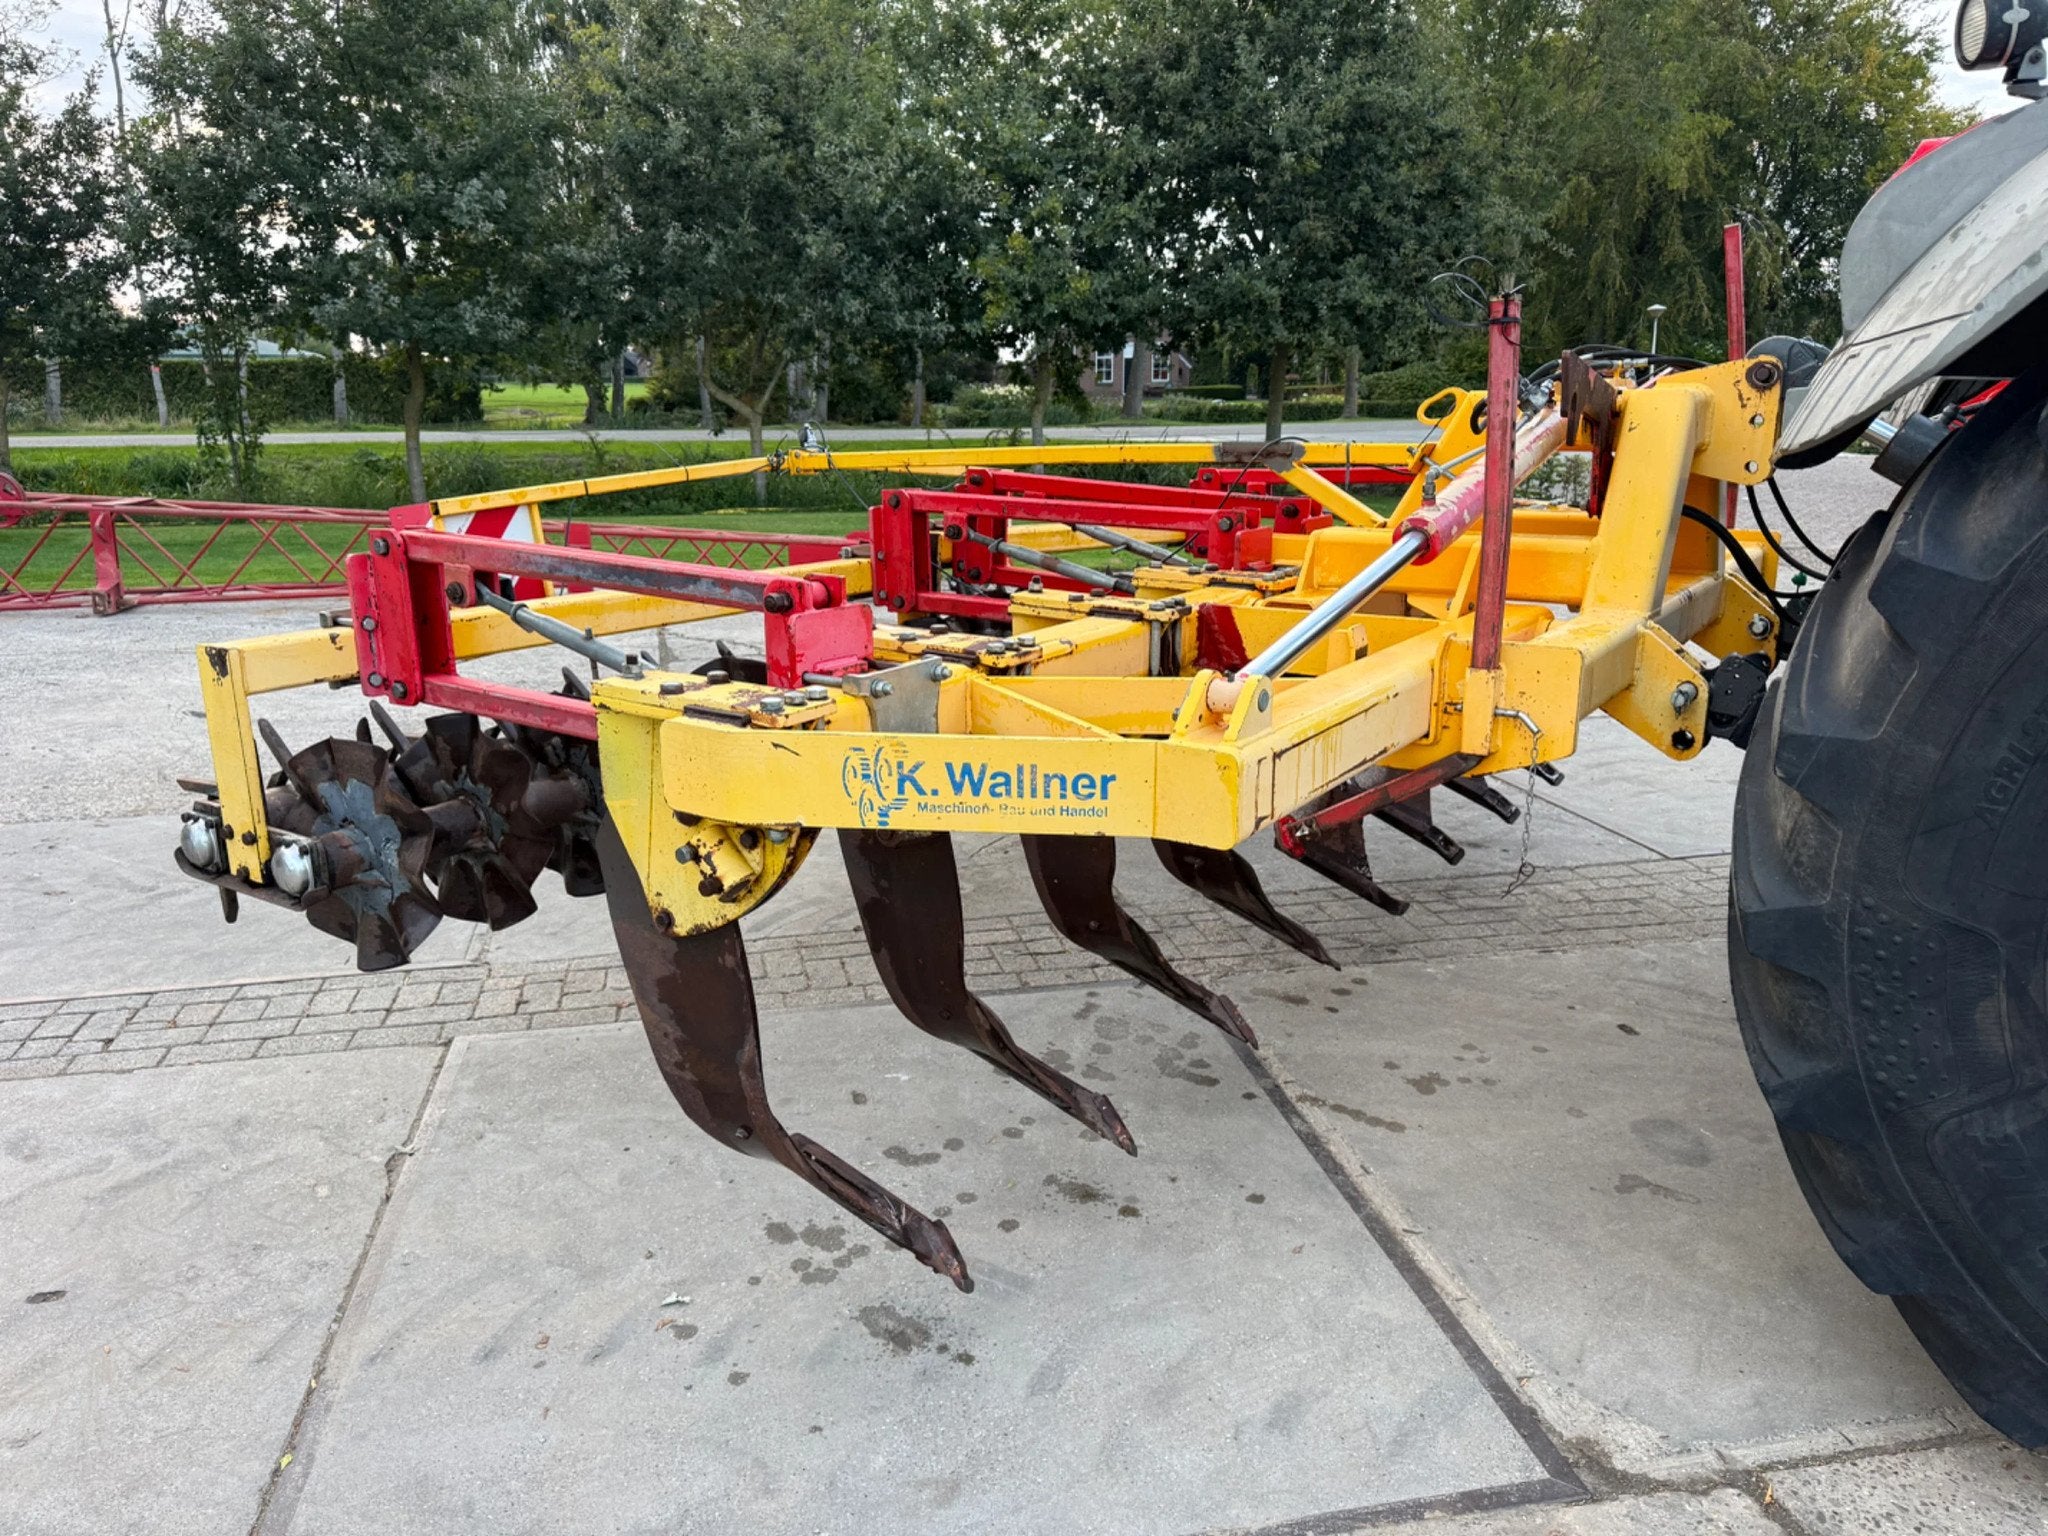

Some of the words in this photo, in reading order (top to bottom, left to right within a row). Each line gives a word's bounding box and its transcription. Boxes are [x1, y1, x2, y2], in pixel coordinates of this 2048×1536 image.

[896, 760, 939, 797] K.
[944, 761, 1117, 801] Wallner
[1030, 805, 1056, 817] und
[1059, 805, 1109, 818] Handel
